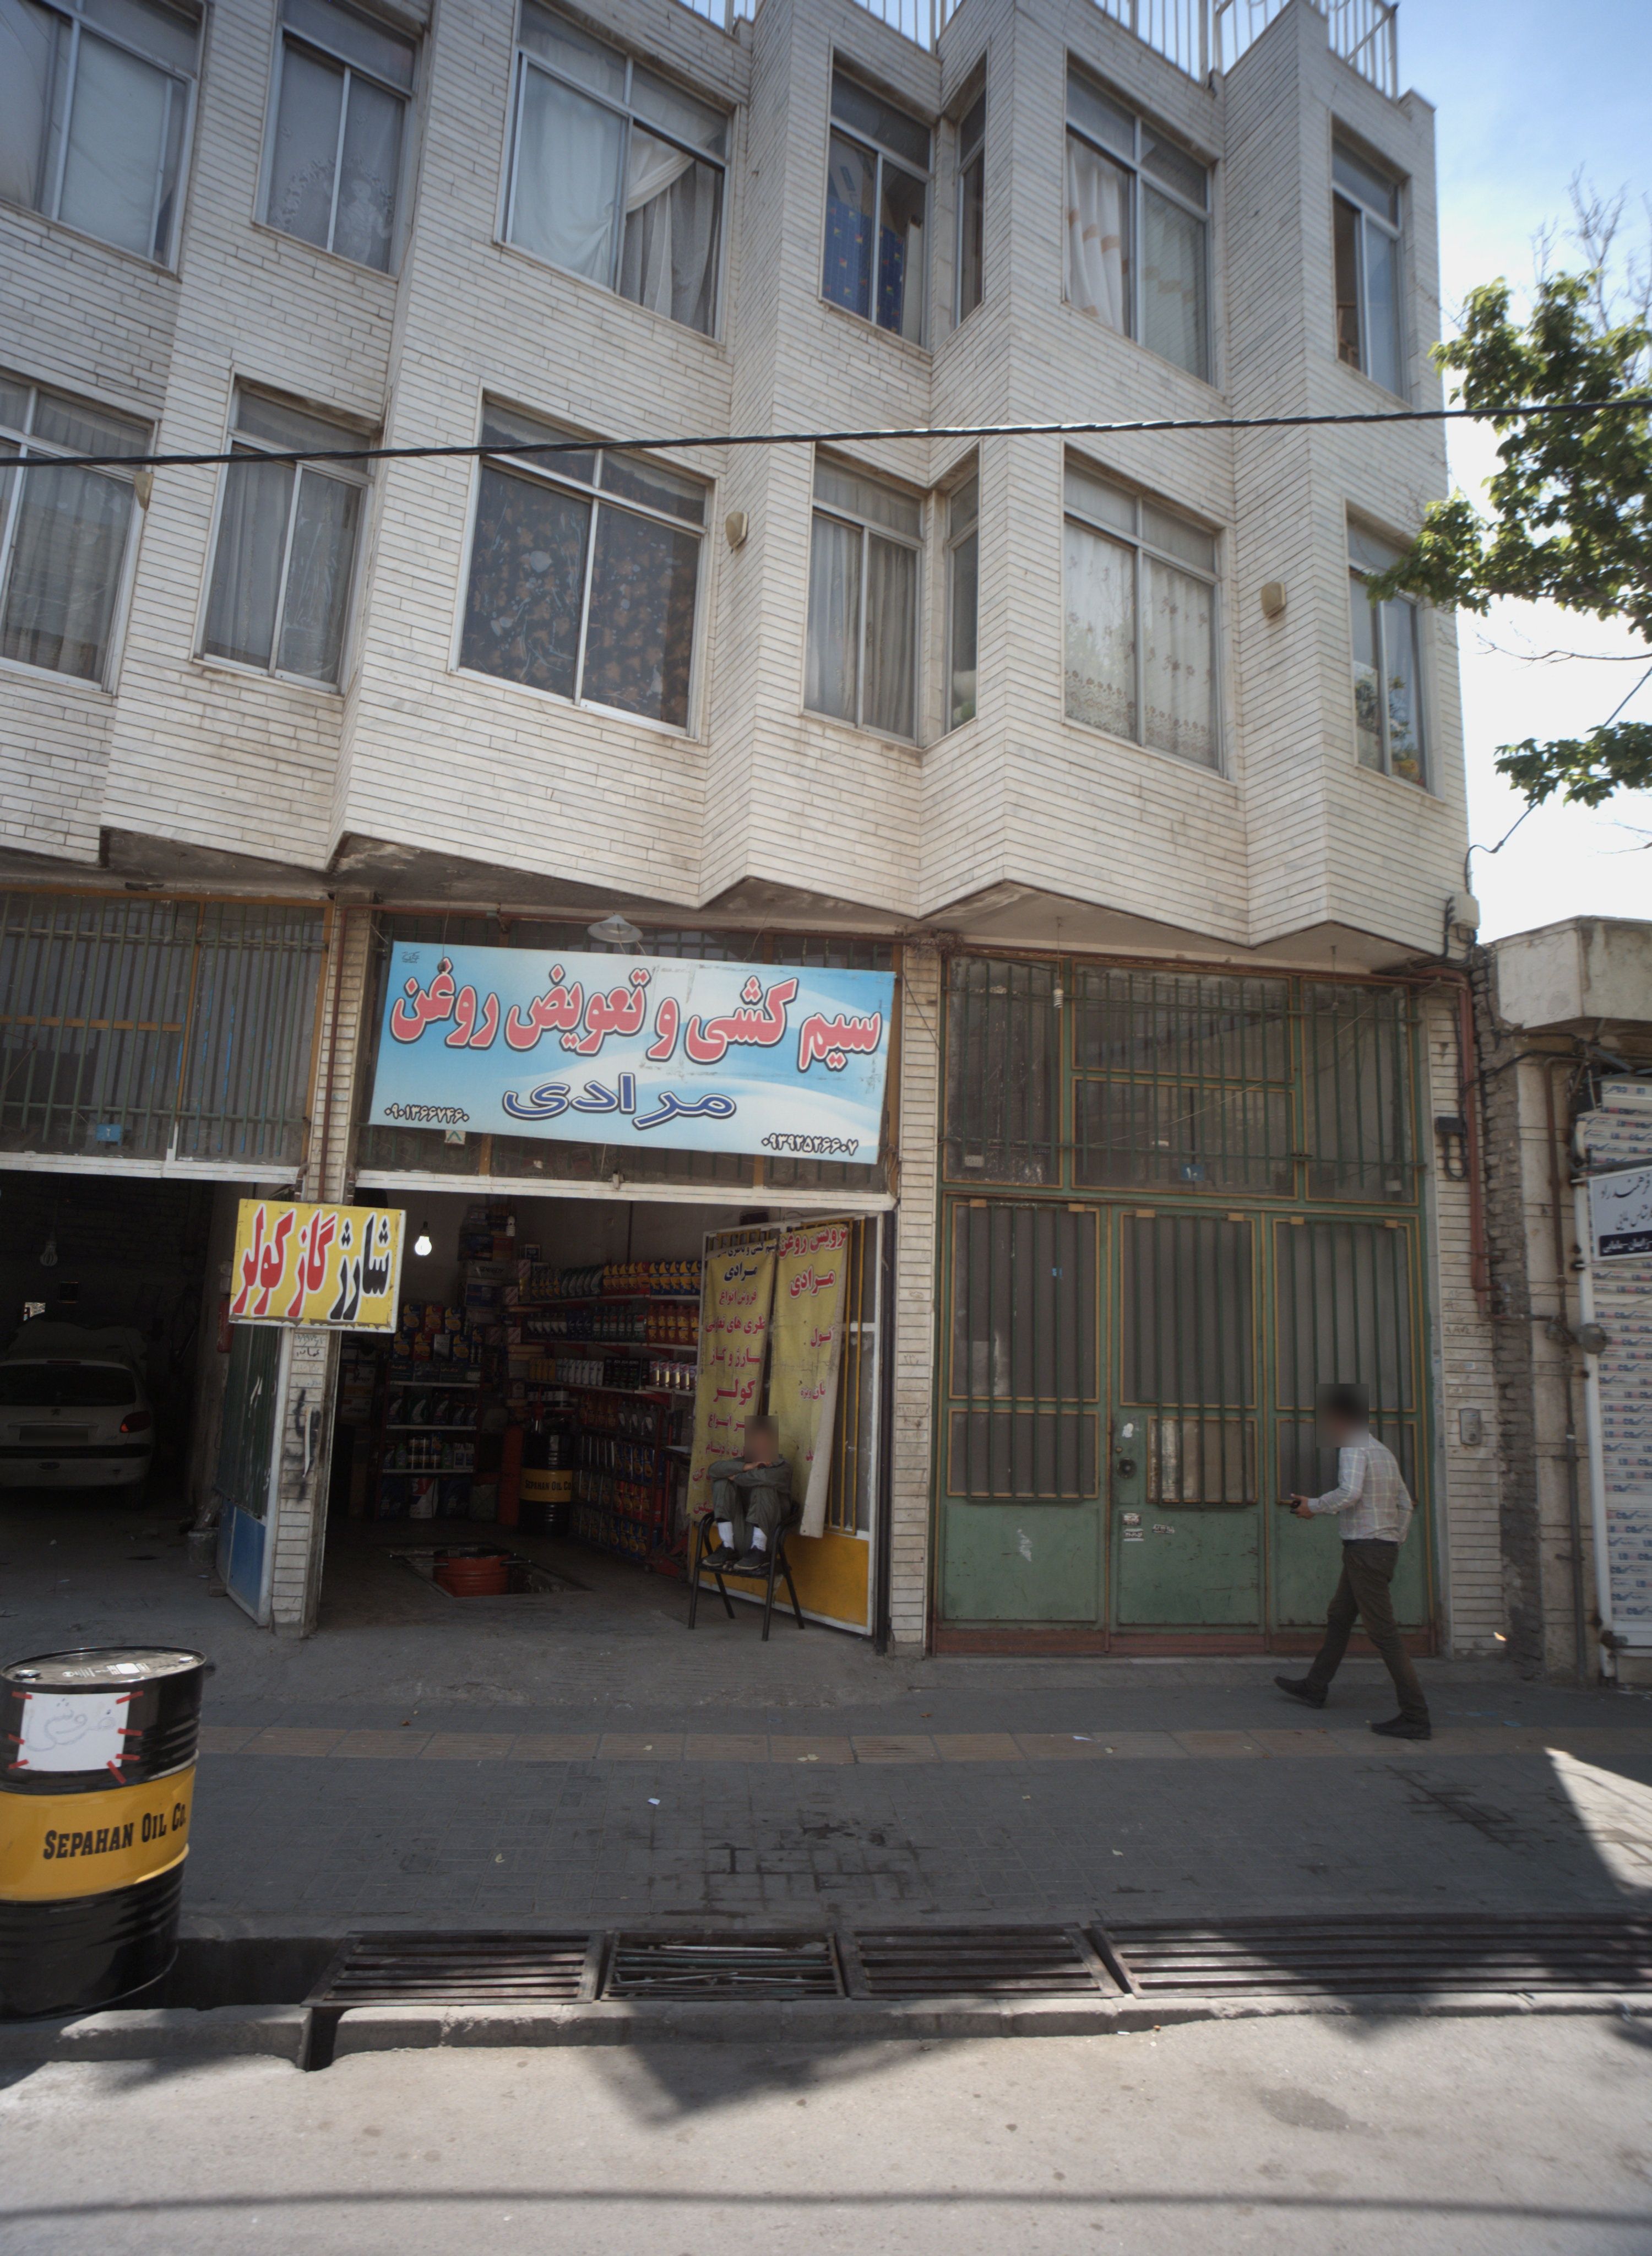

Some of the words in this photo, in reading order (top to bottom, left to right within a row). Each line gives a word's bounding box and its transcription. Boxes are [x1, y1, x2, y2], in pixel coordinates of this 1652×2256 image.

[390, 957, 499, 1048] روغن
[506, 963, 651, 1056] تعویض
[645, 997, 680, 1062] و
[686, 975, 799, 1064] کشی
[797, 1010, 883, 1072] سیم
[503, 1073, 736, 1130] مرادی
[232, 1203, 296, 1315] کولر
[286, 1209, 338, 1317] گاز
[328, 1212, 392, 1321] شارژ
[724, 1261, 758, 1282] مرادی
[779, 1233, 807, 1259] روغن
[790, 1265, 835, 1299] مرادی
[728, 1353, 733, 1367] و
[735, 1346, 762, 1367] ارژ
[713, 1378, 756, 1405] کولر
[42, 1821, 134, 1861] SEPAHAN
[142, 1812, 167, 1842] OIL
